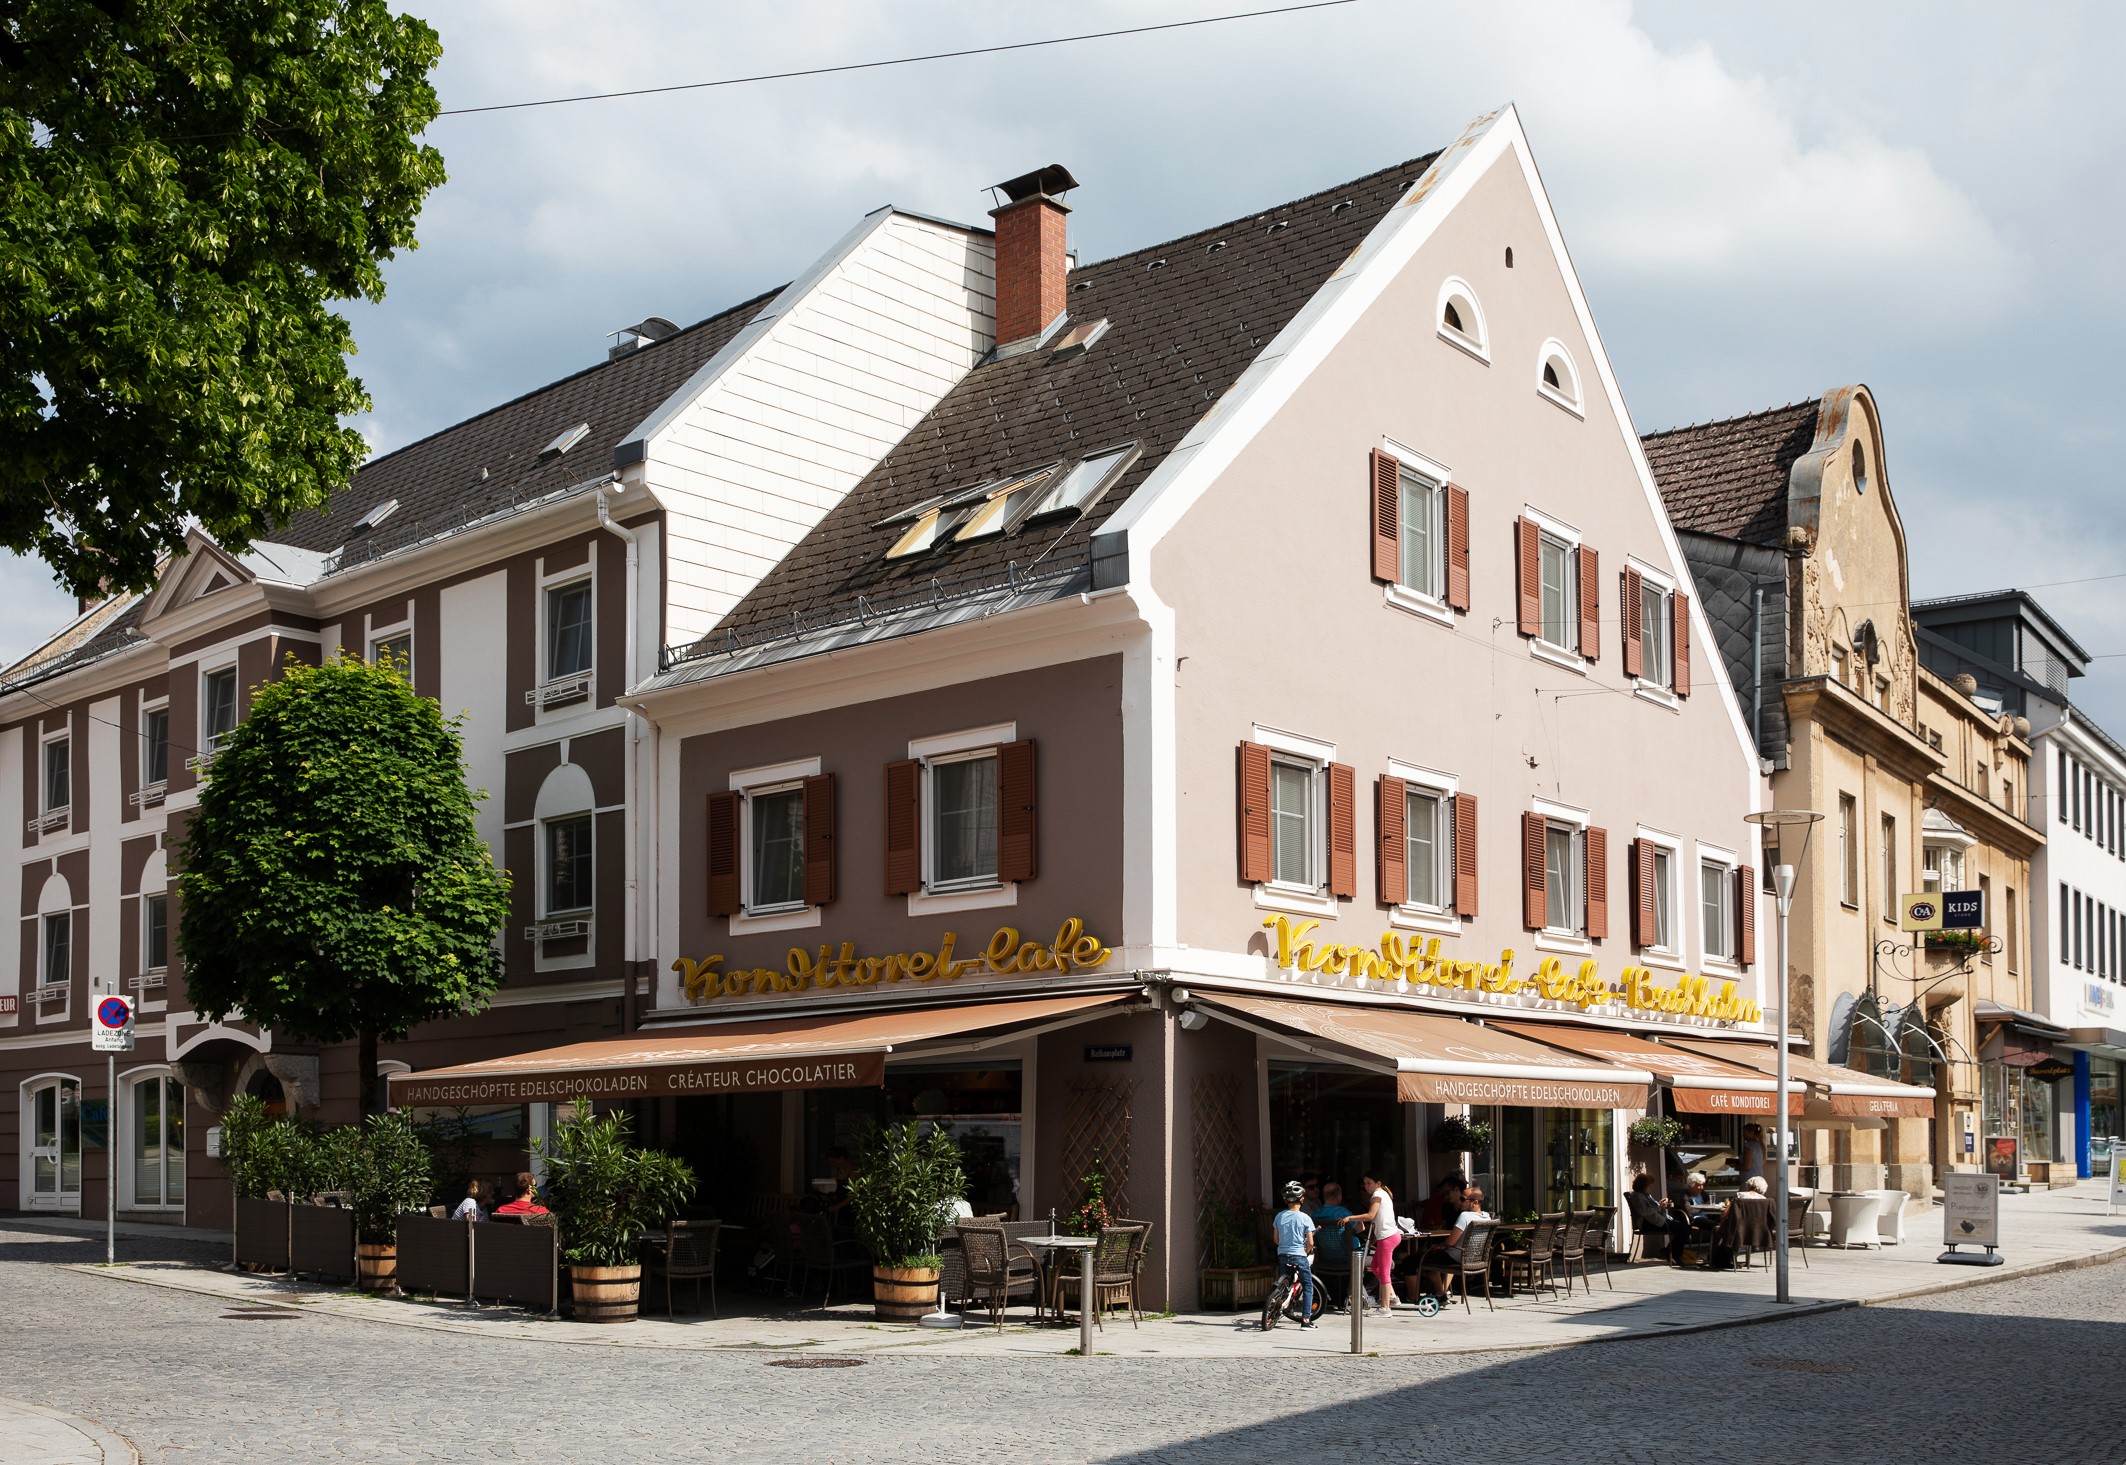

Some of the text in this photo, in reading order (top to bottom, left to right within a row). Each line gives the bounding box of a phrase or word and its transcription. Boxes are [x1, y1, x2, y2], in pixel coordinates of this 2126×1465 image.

[1913, 906, 1931, 917] C&A
[1948, 902, 1978, 913] KIDS
[97, 1029, 131, 1037] LADEZONE
[407, 1063, 857, 1101] HANDGESCHÖPFTE EDELSCHOKOLADEN CRÉATEUR CHOCOLATIER
[1435, 1080, 1620, 1102] HANDGESCHÖPFTE EDELSCHOKOLADEN
[1710, 1093, 1770, 1109] CAFÉ KONDITOREI
